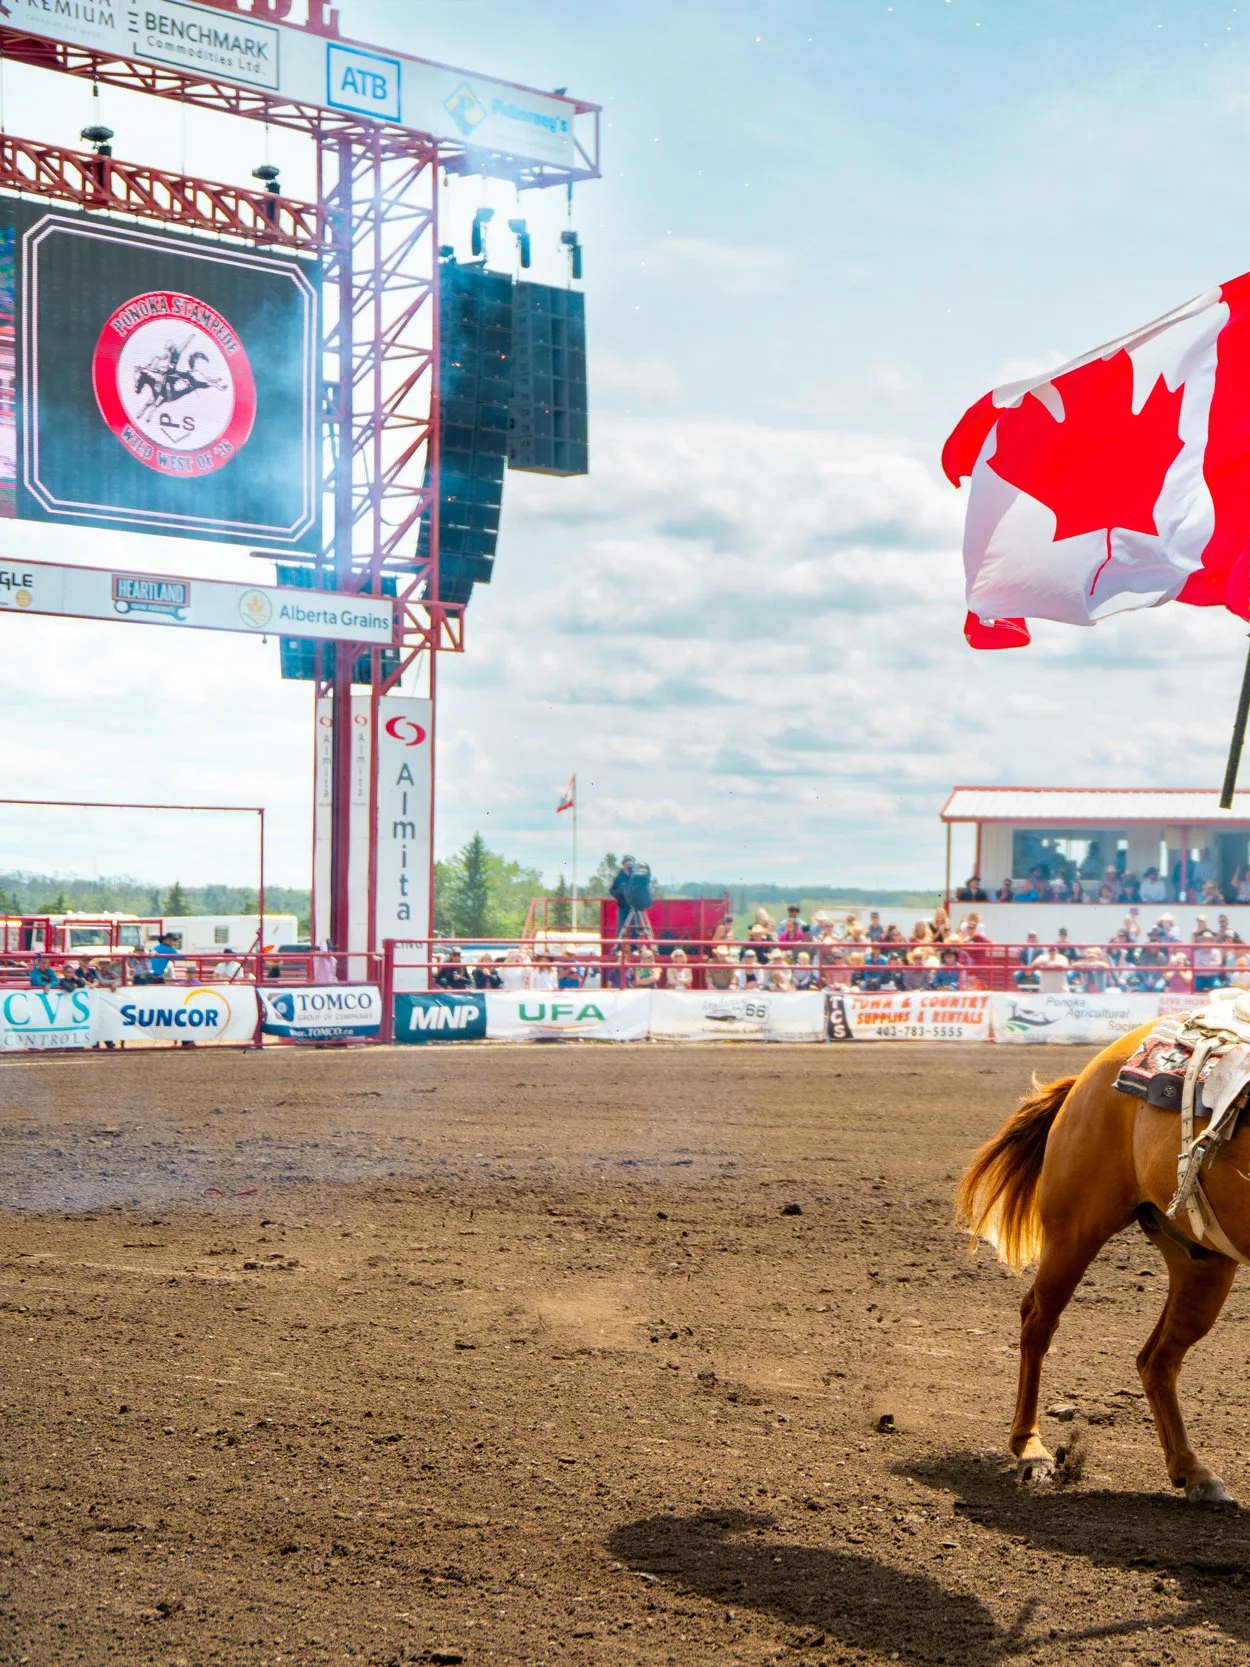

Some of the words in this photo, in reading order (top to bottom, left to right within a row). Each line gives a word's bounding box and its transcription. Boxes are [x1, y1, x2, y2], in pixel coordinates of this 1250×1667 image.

[17, 0, 115, 29] REMIUM
[145, 11, 268, 60] BENCHMARK
[147, 36, 233, 67] Commodities
[238, 57, 266, 76] Ltd.
[340, 65, 388, 101] ATB
[111, 296, 169, 337] PONOKA
[171, 298, 241, 355] STAMPEDE
[157, 450, 192, 472] WEST
[119, 579, 183, 604] HEARTLAND
[279, 602, 338, 626] Alberta
[341, 610, 390, 631] Grains
[393, 762, 416, 921] Almita
[3, 990, 91, 1026] CVS
[296, 992, 373, 1012] TOMCO
[517, 1002, 606, 1022] UFA
[744, 1003, 768, 1019] 66
[920, 996, 990, 1010] COUNTRY
[1045, 996, 1087, 1009] Ponoka
[1066, 1007, 1131, 1020] Agricultural
[120, 1004, 219, 1028] SUNCOR
[408, 1006, 481, 1031] MNP
[856, 1011, 911, 1025] SUPPLIES
[931, 1011, 985, 1025] RENTALS
[1107, 1020, 1144, 1032] Societ
[3, 1031, 92, 1047] CONTROLS
[876, 1026, 963, 1038] 403-783-5555
